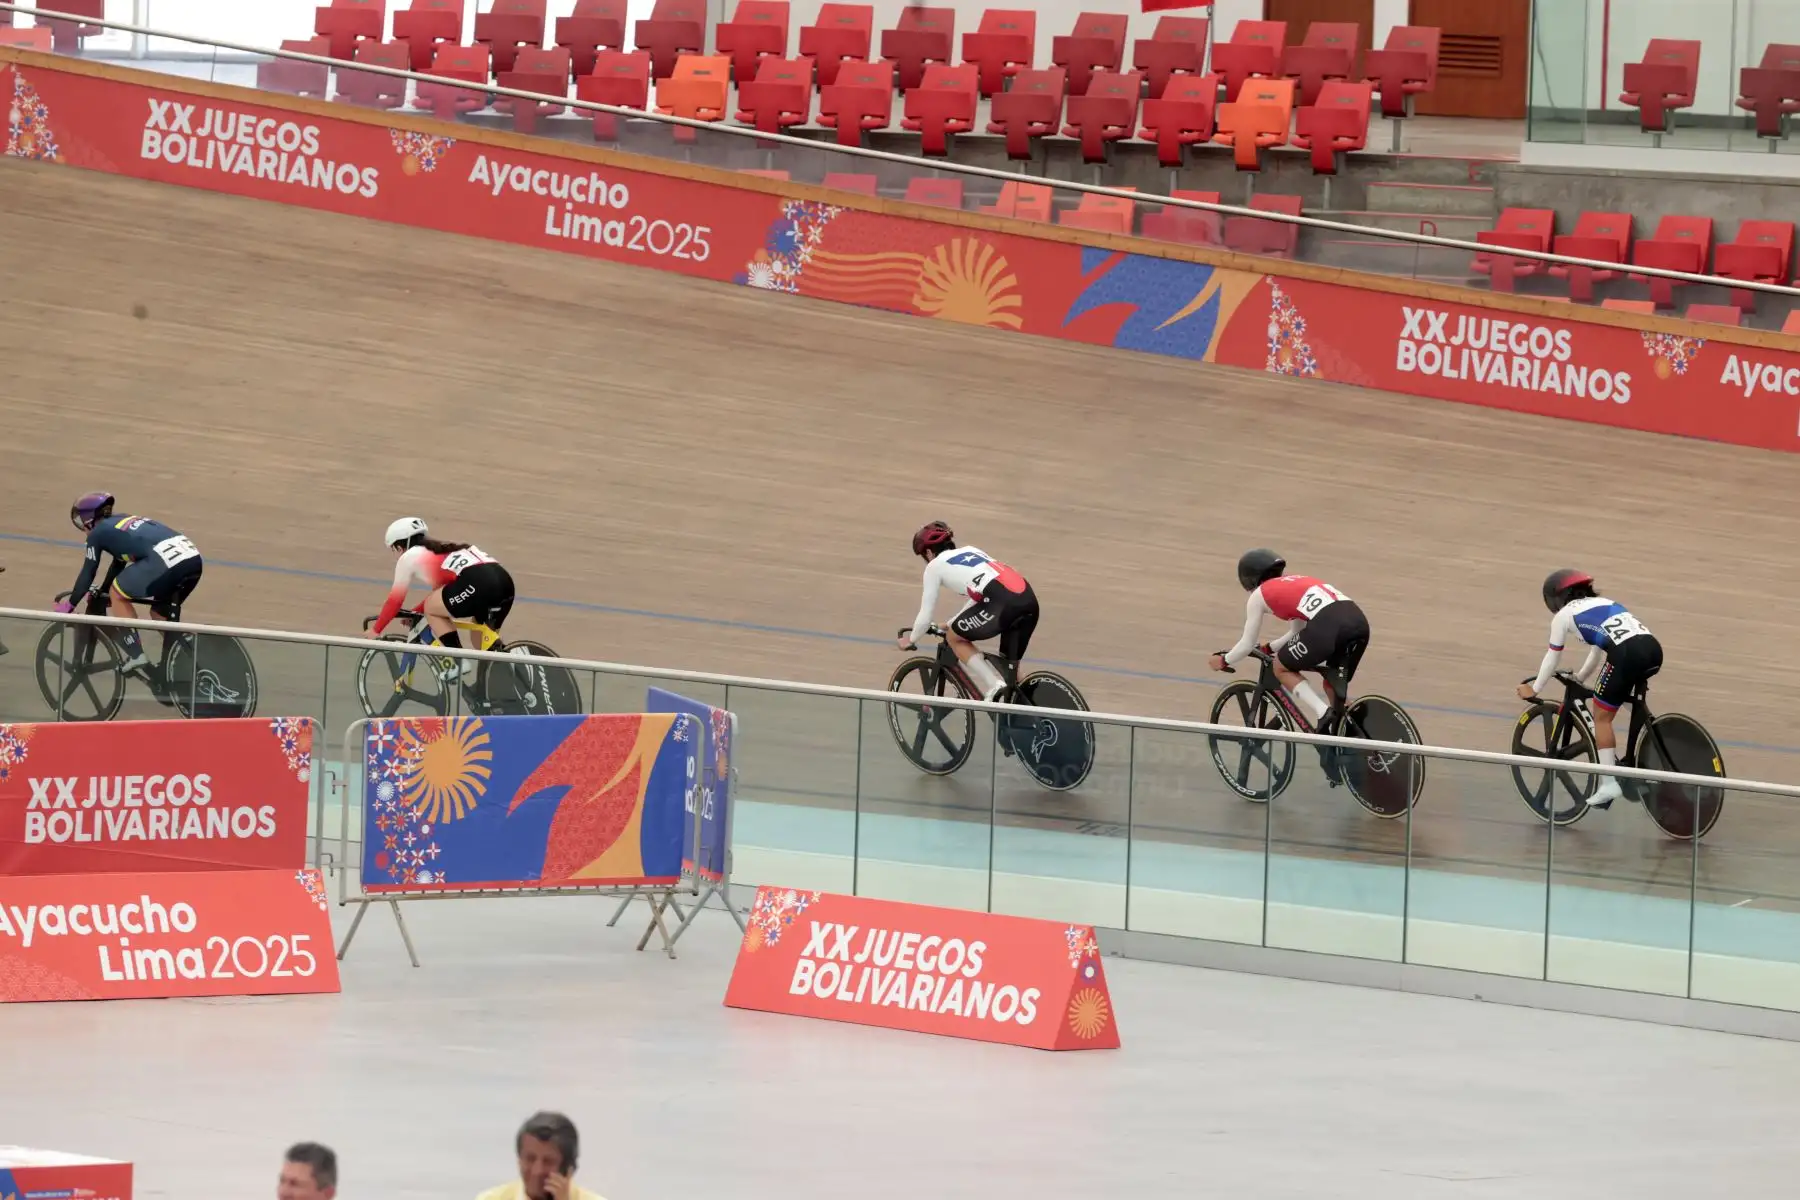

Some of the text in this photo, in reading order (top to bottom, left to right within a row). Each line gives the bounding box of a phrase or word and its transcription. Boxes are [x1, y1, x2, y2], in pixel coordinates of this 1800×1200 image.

[144, 98, 321, 156] XX JUEGOS
[140, 128, 379, 198] BOLIVARIANOS
[467, 155, 630, 210] Ayacucho
[1399, 306, 1572, 362] XX JUEGOS
[1396, 338, 1632, 404] BOLIVARIANOS
[448, 584, 476, 606] PERU
[971, 572, 986, 588] 4
[1301, 593, 1323, 612] 19
[957, 609, 995, 632] CHILE
[1603, 618, 1631, 641] 24
[27, 773, 212, 810] XX JUEGOS
[24, 804, 276, 844] BOLIVARIANOS
[800, 920, 987, 978] XX JUEGOS
[788, 957, 1041, 1025] BOLIVARIANOS
